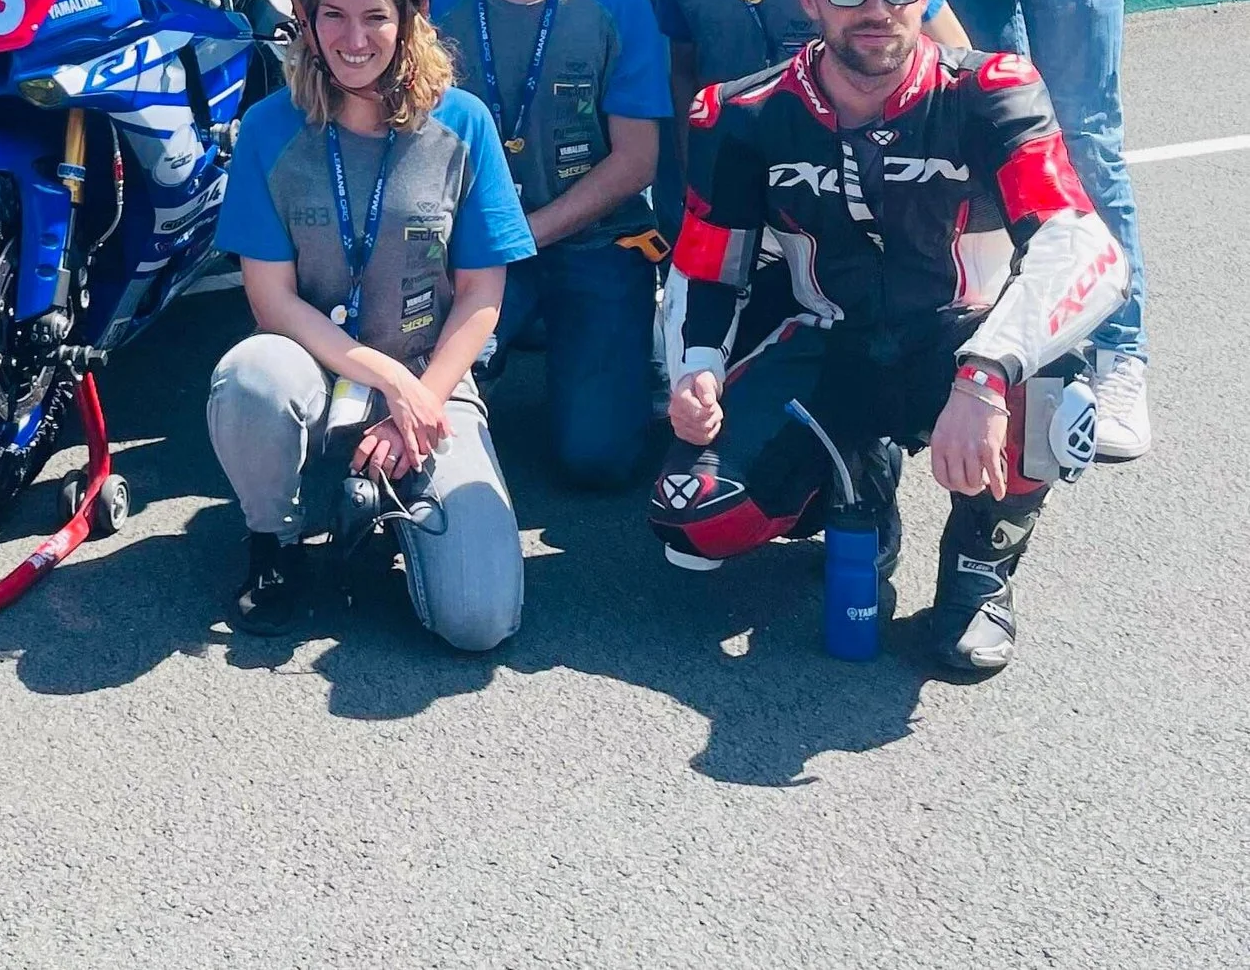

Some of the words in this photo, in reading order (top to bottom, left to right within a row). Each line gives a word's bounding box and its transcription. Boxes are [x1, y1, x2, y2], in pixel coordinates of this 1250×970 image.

[478, 2, 489, 40] LEMANS
[534, 29, 547, 67] LEMANS
[334, 152, 345, 196] LEMANS
[370, 178, 383, 221] LEMANS
[1049, 242, 1118, 336] IXON
